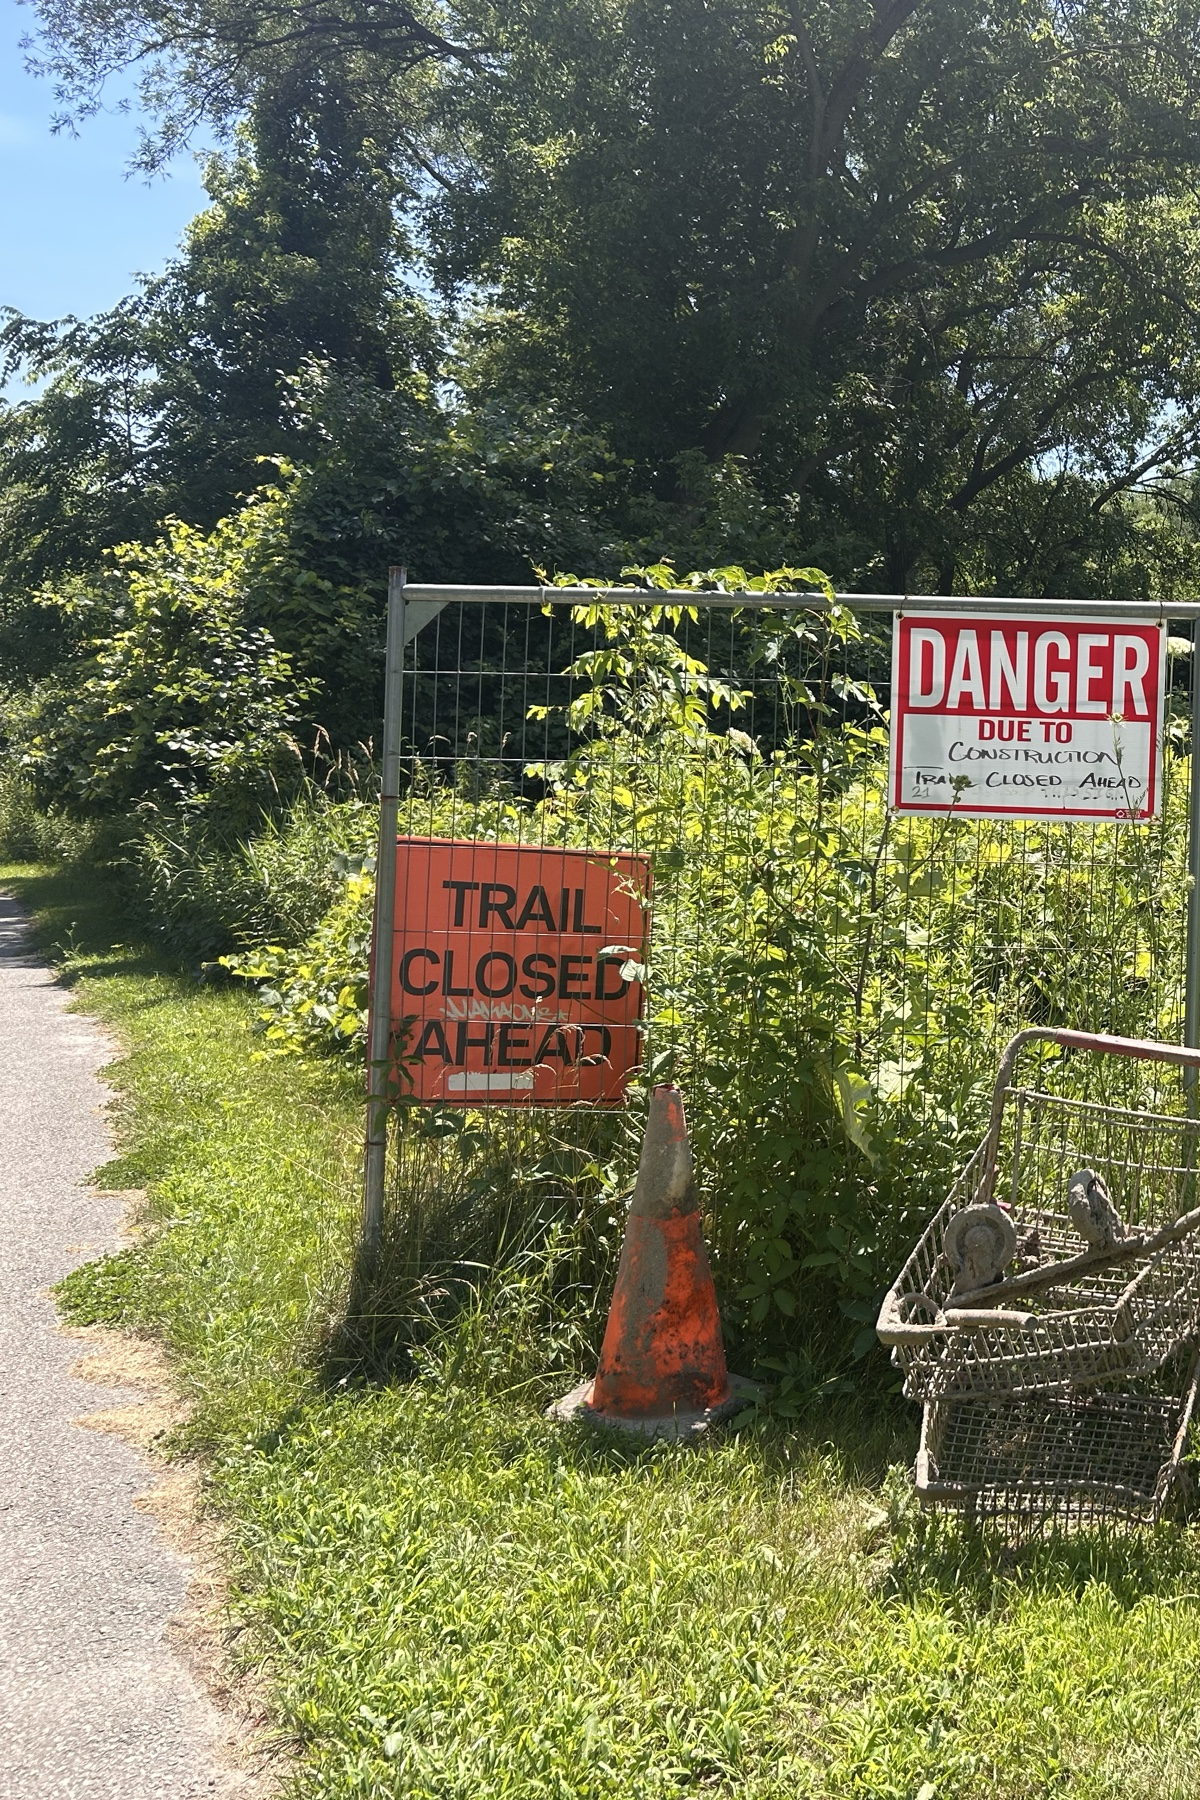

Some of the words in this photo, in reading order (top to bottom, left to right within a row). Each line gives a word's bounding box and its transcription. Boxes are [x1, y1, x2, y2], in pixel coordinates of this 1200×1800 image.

[909, 627, 1150, 716] DANGER
[948, 741, 1118, 766] CONSTRUCTION
[978, 719, 1032, 742] DUE
[1040, 721, 1072, 743] TO
[986, 771, 1062, 788] CLOSED
[1079, 772, 1141, 789] AHEAD
[443, 880, 602, 933] TRAIL
[399, 948, 631, 1001] CLOSED
[409, 1019, 612, 1067] AHEAD
